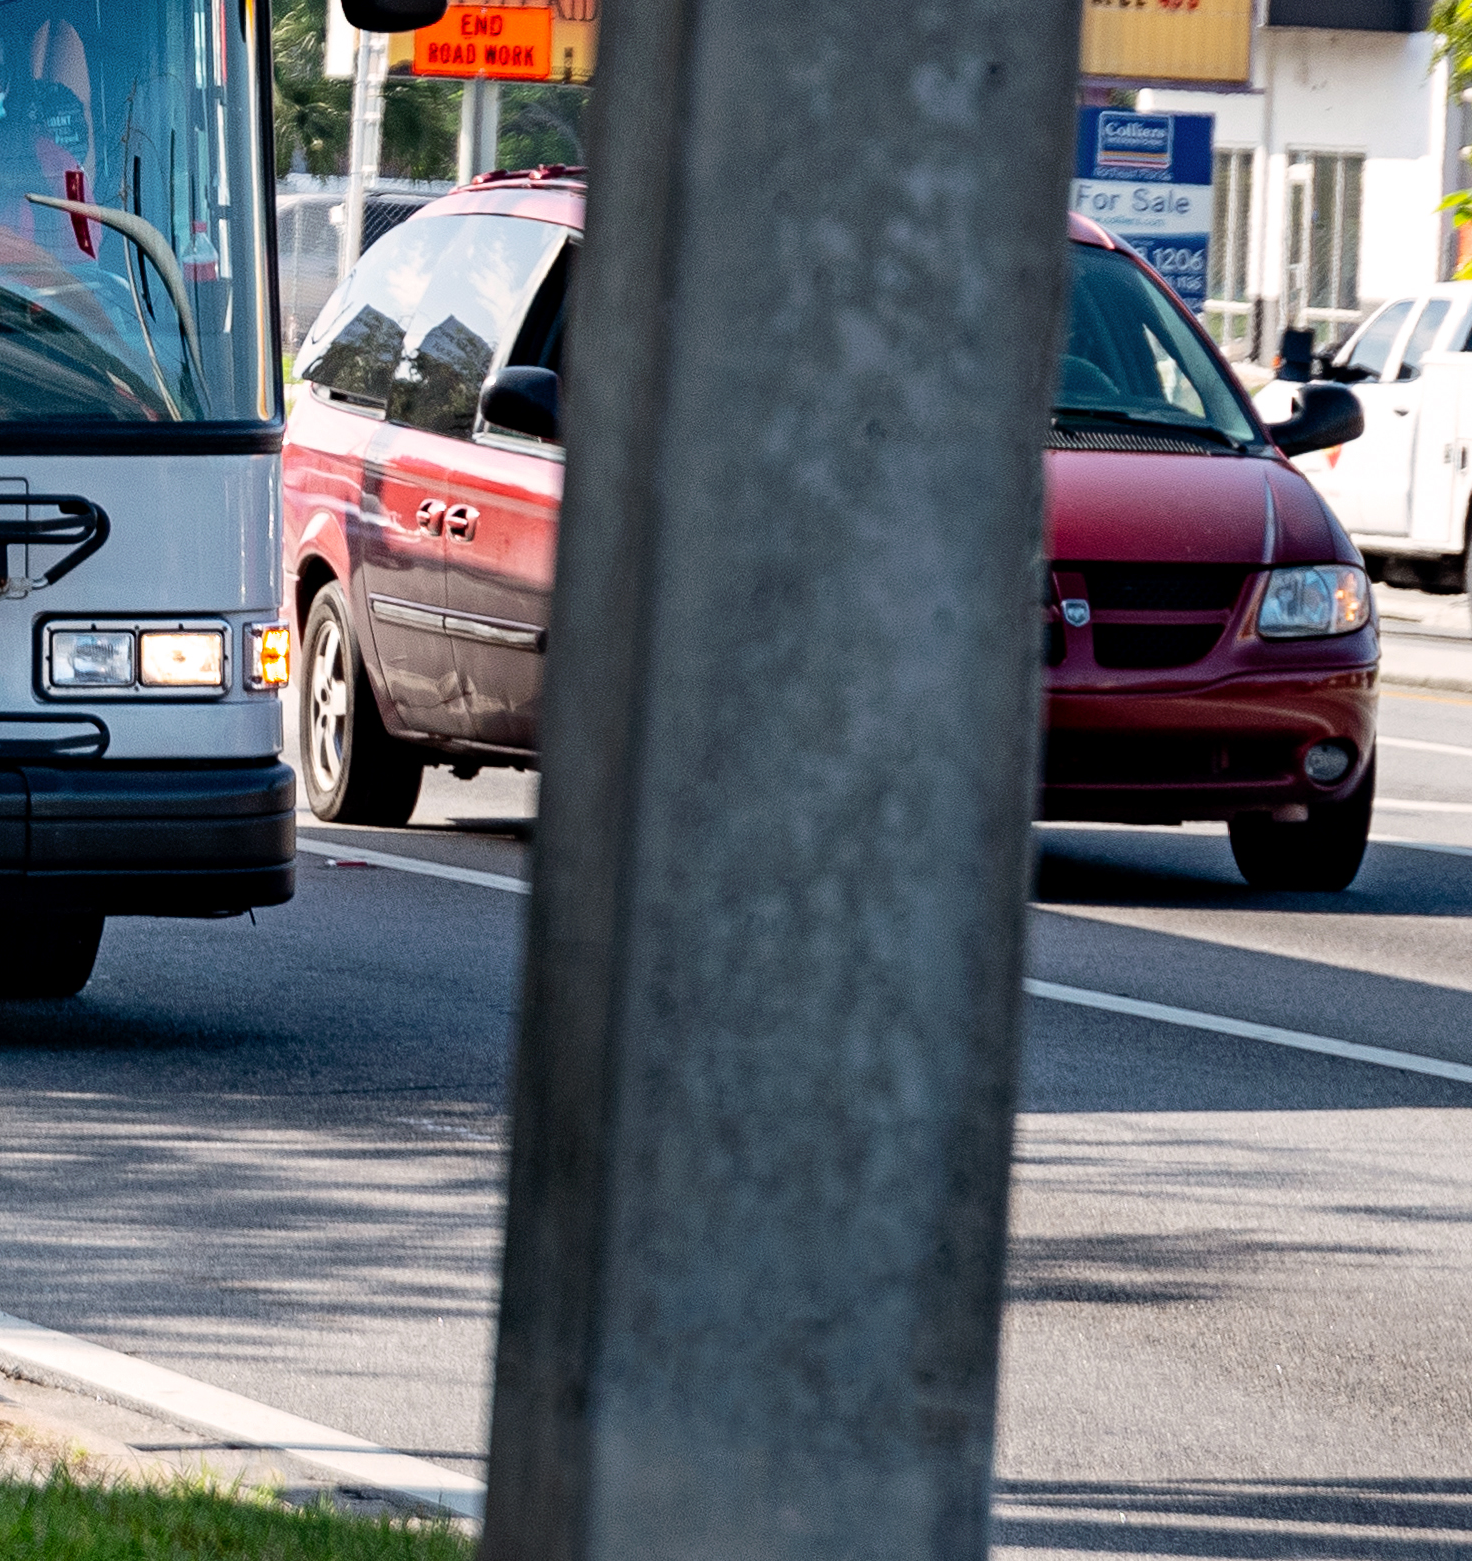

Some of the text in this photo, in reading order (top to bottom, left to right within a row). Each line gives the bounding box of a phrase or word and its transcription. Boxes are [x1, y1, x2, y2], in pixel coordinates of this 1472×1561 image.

[461, 13, 504, 37] END
[428, 42, 535, 67] ROAD WORK
[1105, 120, 1167, 139] Colliers
[1075, 184, 1192, 215] For Sale
